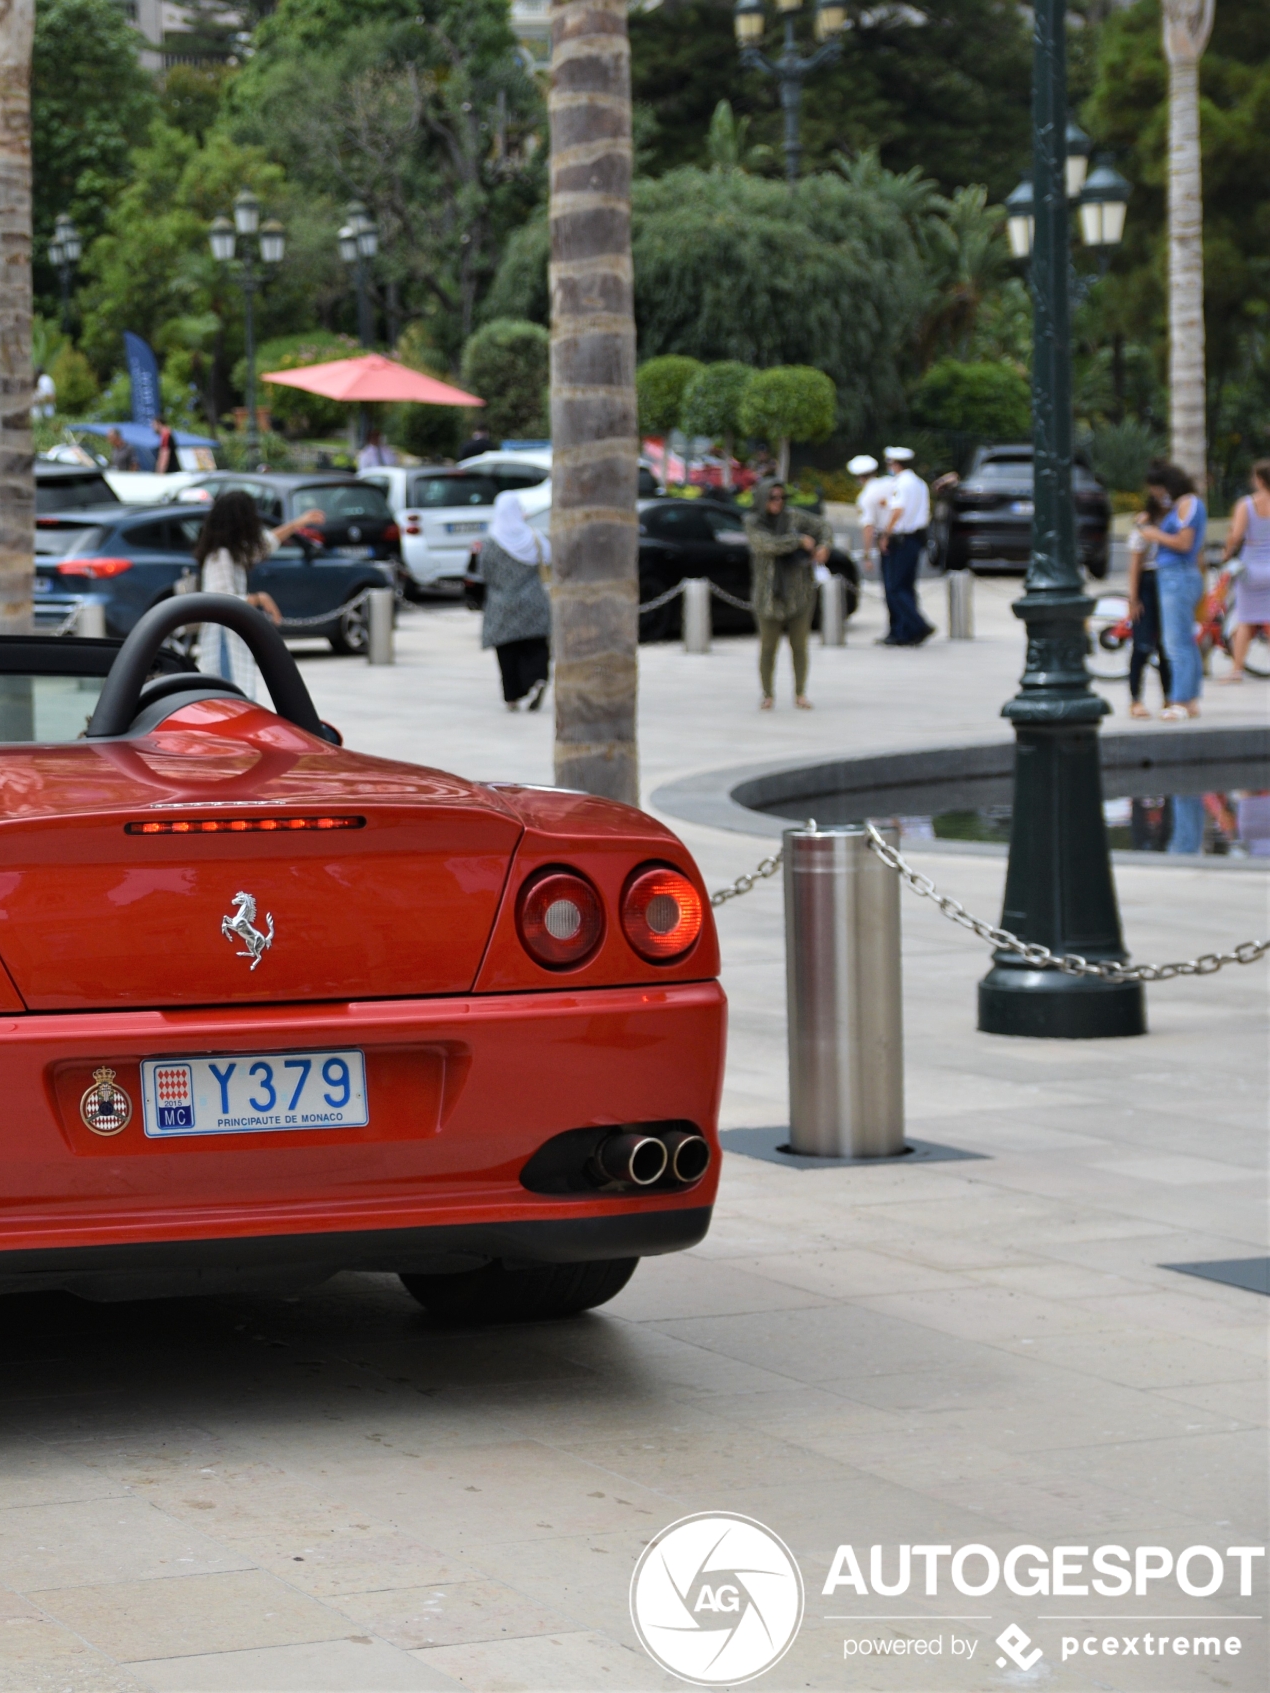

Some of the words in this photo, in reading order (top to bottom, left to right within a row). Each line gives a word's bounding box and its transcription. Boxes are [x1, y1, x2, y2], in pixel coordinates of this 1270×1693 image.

[208, 1057, 351, 1115] Y379
[164, 1109, 186, 1126] MC
[217, 1115, 281, 1128] PRINCIPAUTE
[285, 1114, 298, 1124] DE
[301, 1112, 344, 1123] MONACO
